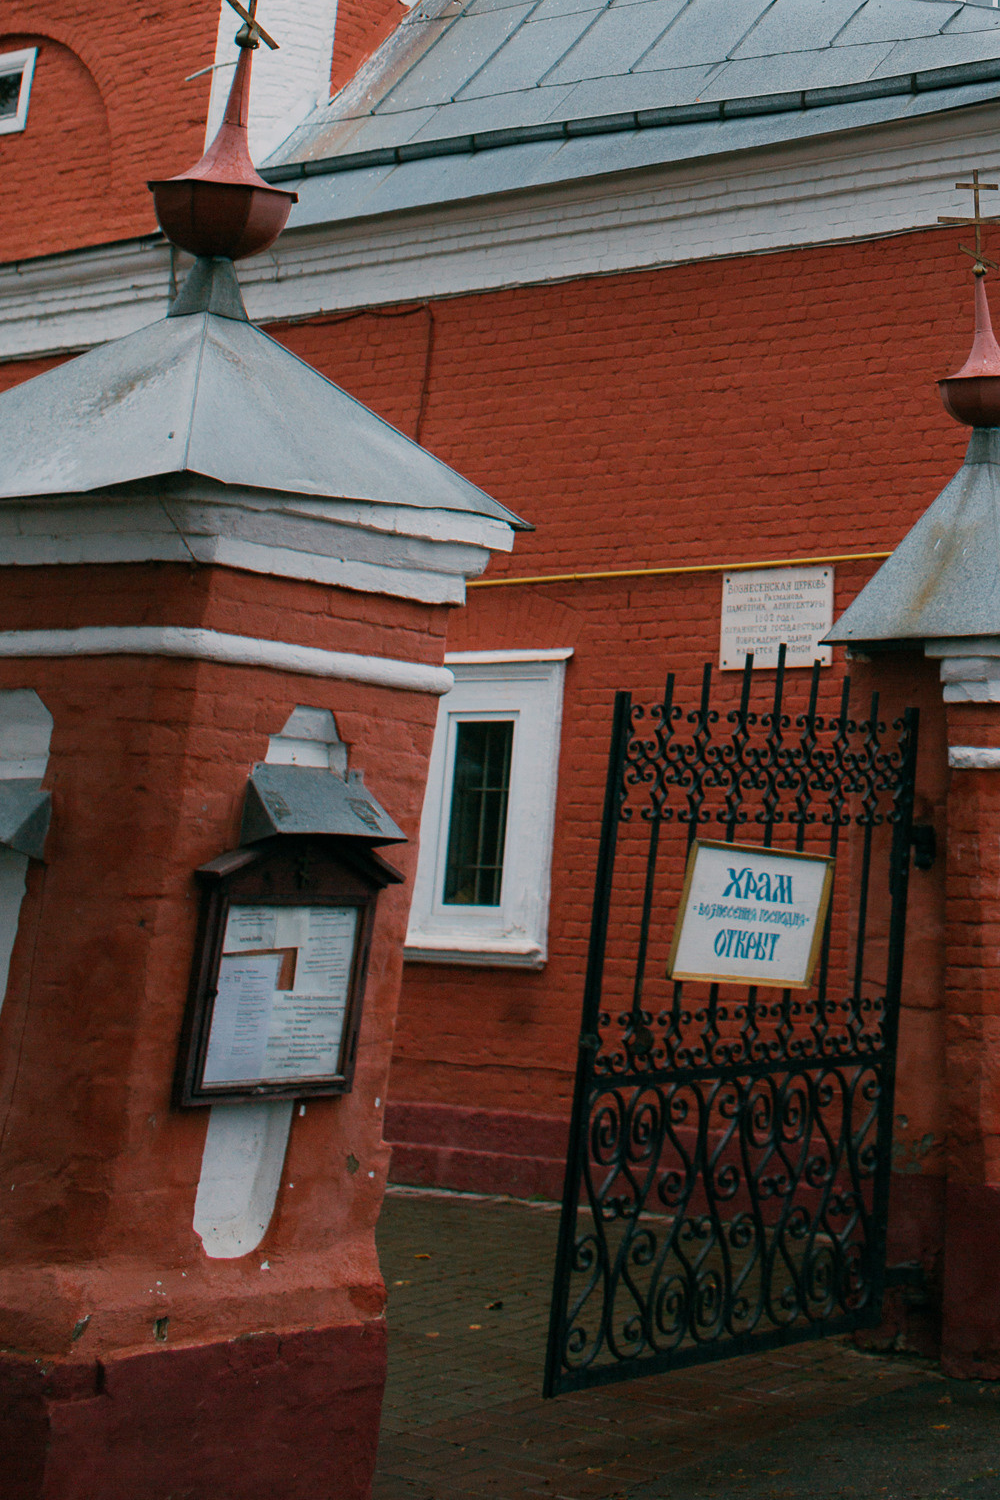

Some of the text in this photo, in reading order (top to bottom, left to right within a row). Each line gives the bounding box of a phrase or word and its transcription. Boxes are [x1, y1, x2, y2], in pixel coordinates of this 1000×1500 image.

[728, 579, 825, 594] ВОЗНЕСЕНСКАЯ ЦЕРКОВЬ
[727, 601, 825, 613] ПАМЯТНИК АРХИТЕКТУРЫ
[714, 928, 780, 961] ОТКРЫТ
